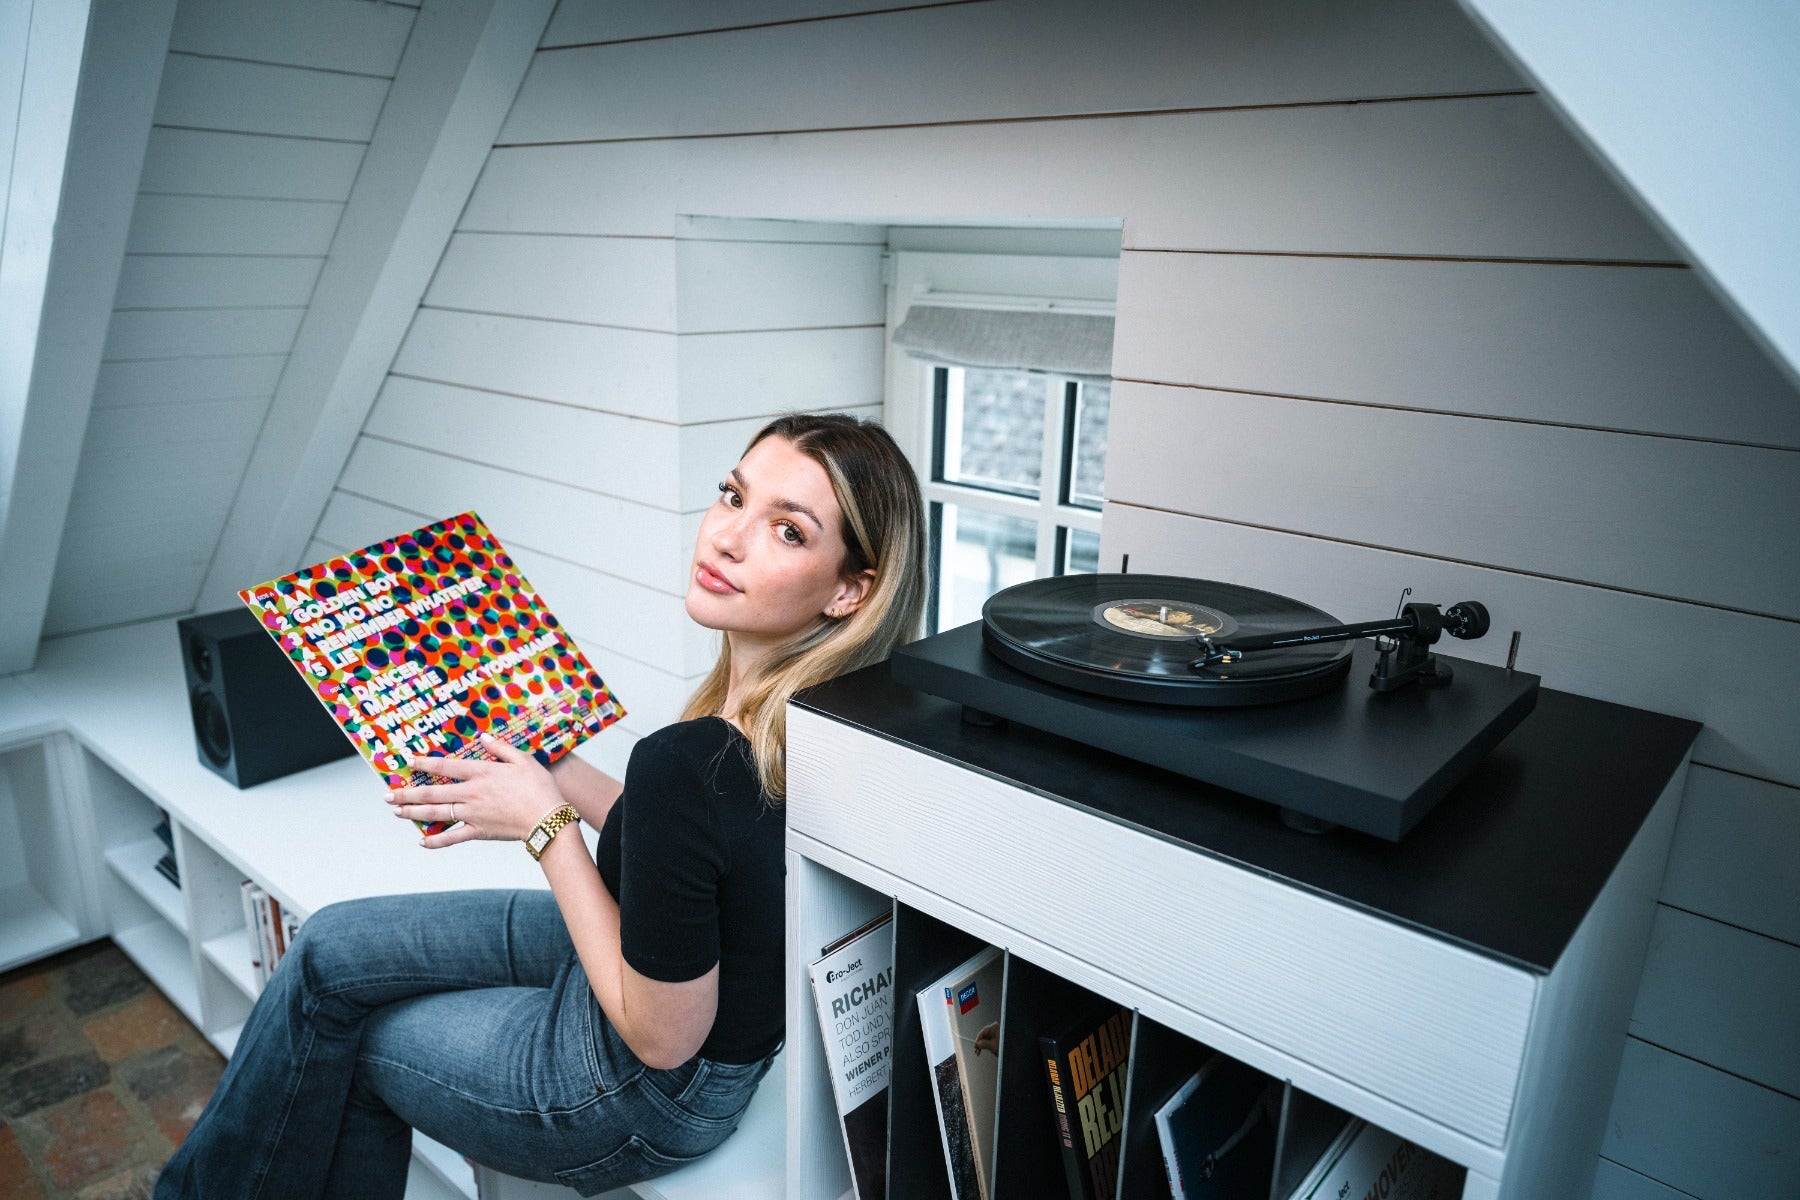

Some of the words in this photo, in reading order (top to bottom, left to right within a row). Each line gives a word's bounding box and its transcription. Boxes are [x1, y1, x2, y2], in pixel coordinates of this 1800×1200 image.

[264, 601, 279, 614] 1
[284, 590, 307, 609] AA
[276, 616, 292, 631] 2
[292, 586, 367, 623] GOLDEN
[364, 572, 399, 596] BOY
[302, 646, 316, 660] 4
[315, 608, 411, 652] REMEMBER
[405, 576, 487, 616] WHATEVER
[288, 632, 303, 646] 3
[303, 618, 336, 639] NO
[335, 606, 366, 628] NO
[364, 595, 394, 615] NO
[310, 662, 327, 676] 5
[326, 649, 360, 670] LIE
[337, 693, 353, 706] 1
[352, 660, 420, 700] DANCER
[349, 708, 365, 724] 2
[362, 683, 416, 716] MAKE
[412, 670, 442, 692] ME
[359, 724, 375, 739] 3
[374, 697, 429, 730] WHEN
[425, 692, 437, 706] I
[434, 669, 480, 702] SPEAK
[517, 632, 559, 660] NAME
[375, 739, 388, 753] 4
[387, 700, 468, 749] MACHINE
[384, 755, 399, 770] 5
[826, 958, 863, 984] Pro-Ject
[960, 987, 976, 1001] DECCA
[836, 1011, 860, 1035] DON
[862, 995, 888, 1020] JUAN
[838, 1029, 861, 1051] TOD
[863, 1014, 885, 1033] UND
[843, 1041, 870, 1067] ALSO
[845, 1051, 882, 1082] WIENER
[848, 1065, 887, 1097] HERBERT
